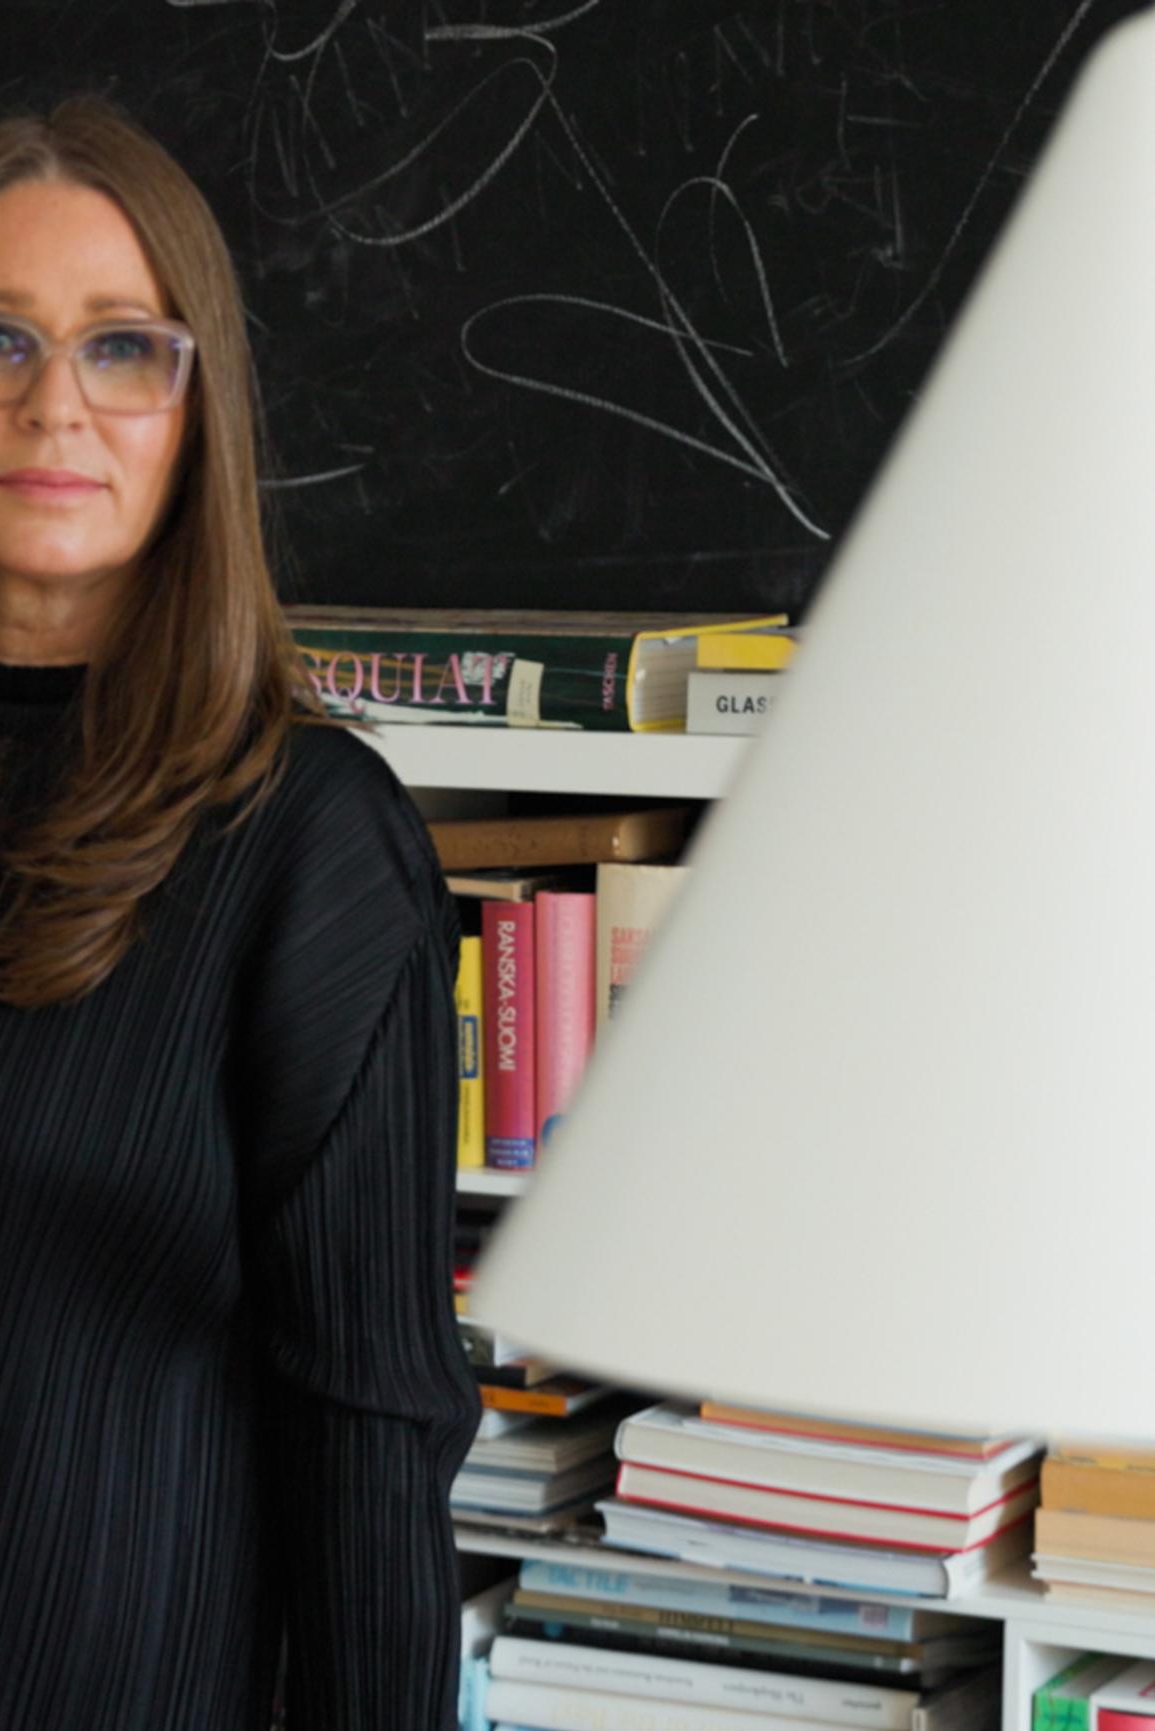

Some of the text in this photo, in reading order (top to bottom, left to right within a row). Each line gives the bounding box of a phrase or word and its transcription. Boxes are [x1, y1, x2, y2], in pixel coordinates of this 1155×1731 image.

[296, 651, 508, 713] SQUIAT
[602, 653, 618, 711] TASCHEN
[716, 695, 770, 714] GLAS
[496, 920, 517, 1072] RANSKA-SUOMI
